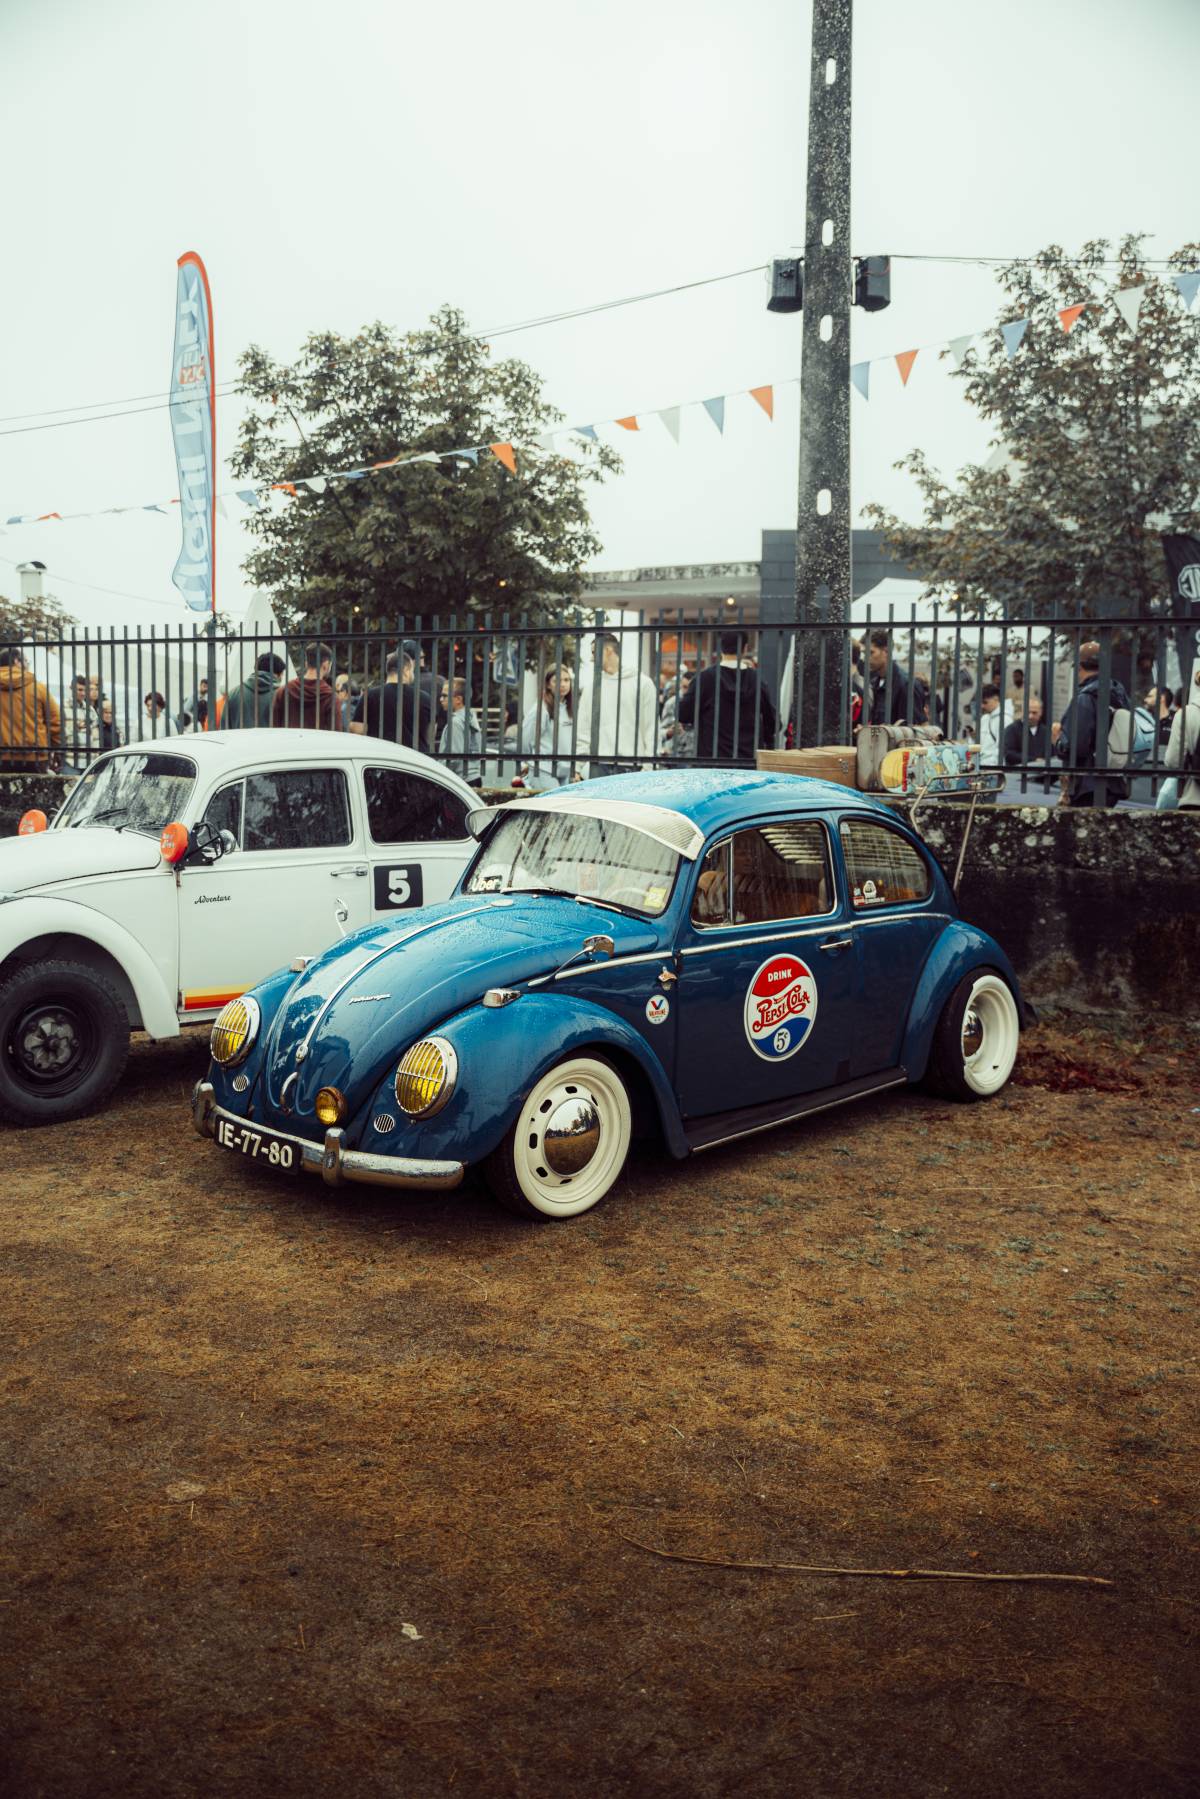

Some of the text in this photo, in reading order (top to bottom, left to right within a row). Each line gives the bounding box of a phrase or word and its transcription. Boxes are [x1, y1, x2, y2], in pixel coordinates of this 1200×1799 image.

[388, 869, 411, 904] 5
[194, 895, 231, 905] Adventure
[768, 968, 793, 983] DRINK
[218, 1120, 293, 1168] IE-77-80
